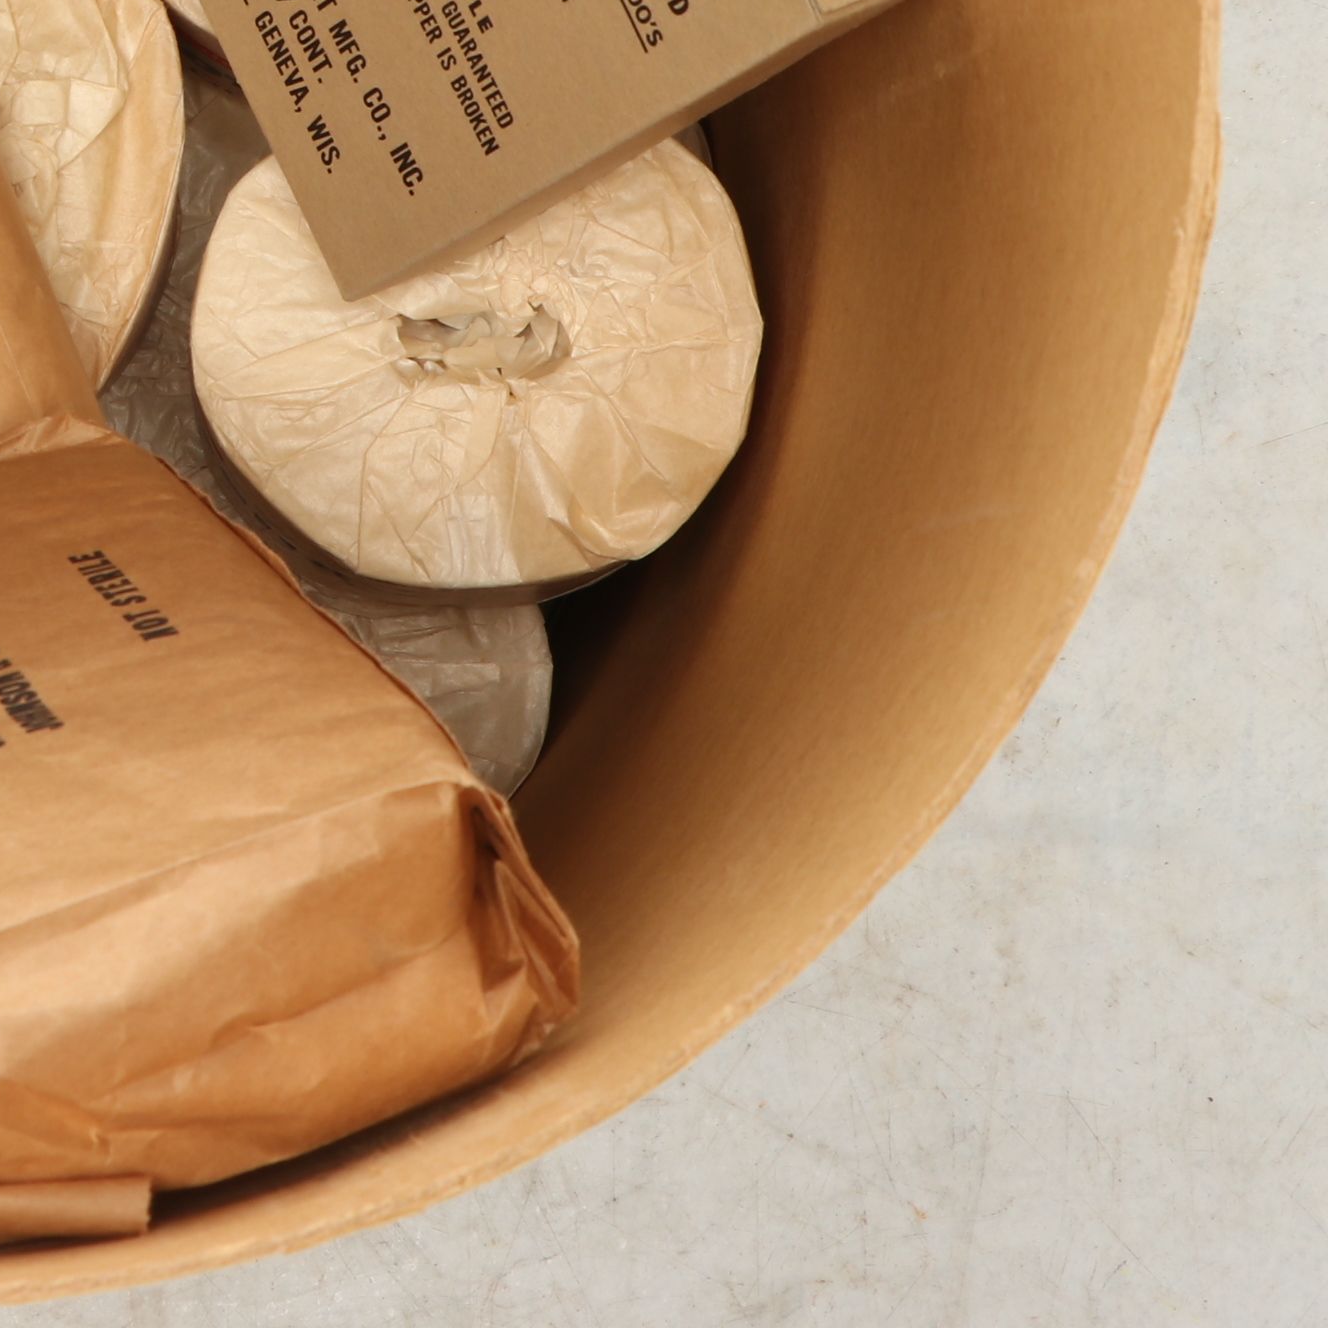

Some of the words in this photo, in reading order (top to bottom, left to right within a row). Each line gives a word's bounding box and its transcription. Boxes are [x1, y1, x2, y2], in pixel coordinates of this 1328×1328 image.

[255, 11, 309, 112] GENEVA,
[307, 114, 340, 174] WIS.
[289, 10, 333, 84] CONT.
[329, 19, 366, 83] MFG.
[363, 87, 391, 140] CO.,
[390, 142, 423, 196] INC.
[437, 47, 457, 71] IS
[450, 75, 500, 156] BROKEN
[442, 1, 513, 129] GUARANTEED
